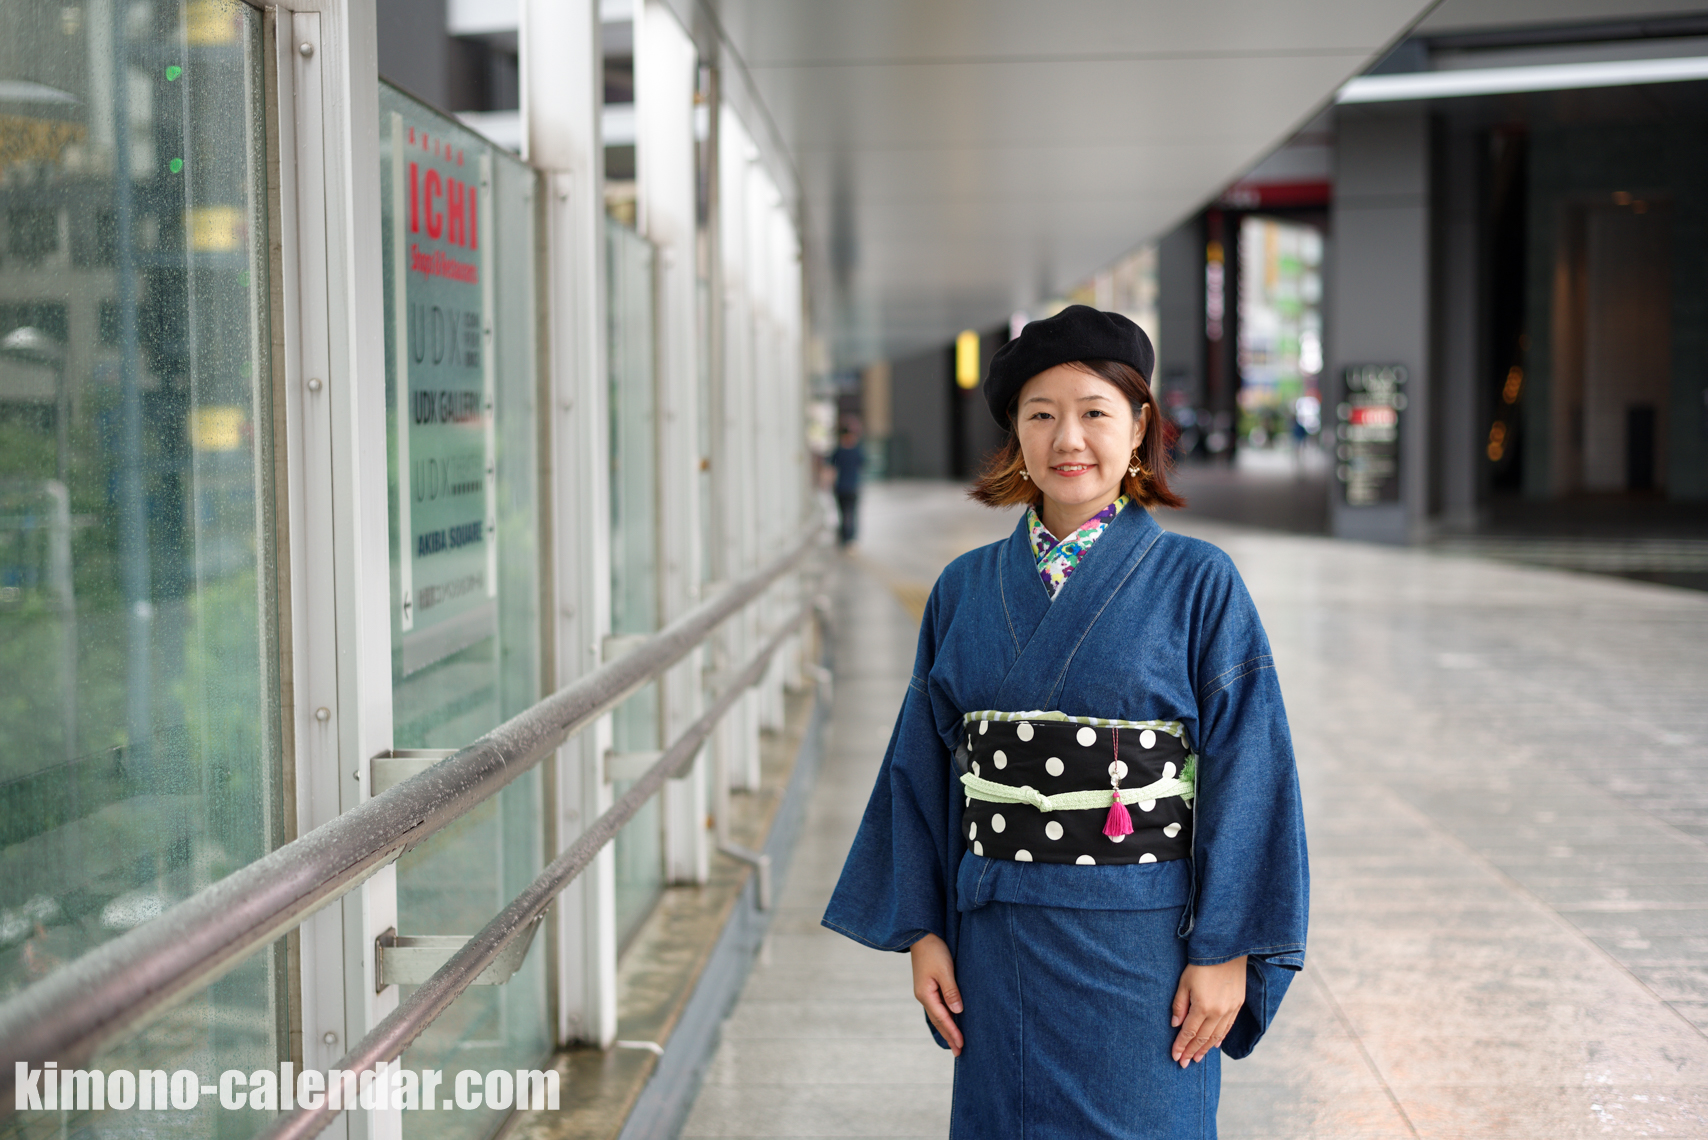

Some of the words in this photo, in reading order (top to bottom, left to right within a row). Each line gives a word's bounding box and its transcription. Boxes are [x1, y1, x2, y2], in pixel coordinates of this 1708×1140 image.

[408, 161, 479, 251] ICHI
[411, 302, 461, 367] UDX
[414, 390, 439, 424] UDX
[417, 529, 447, 558] AKIBA
[449, 520, 484, 550] SQUARE
